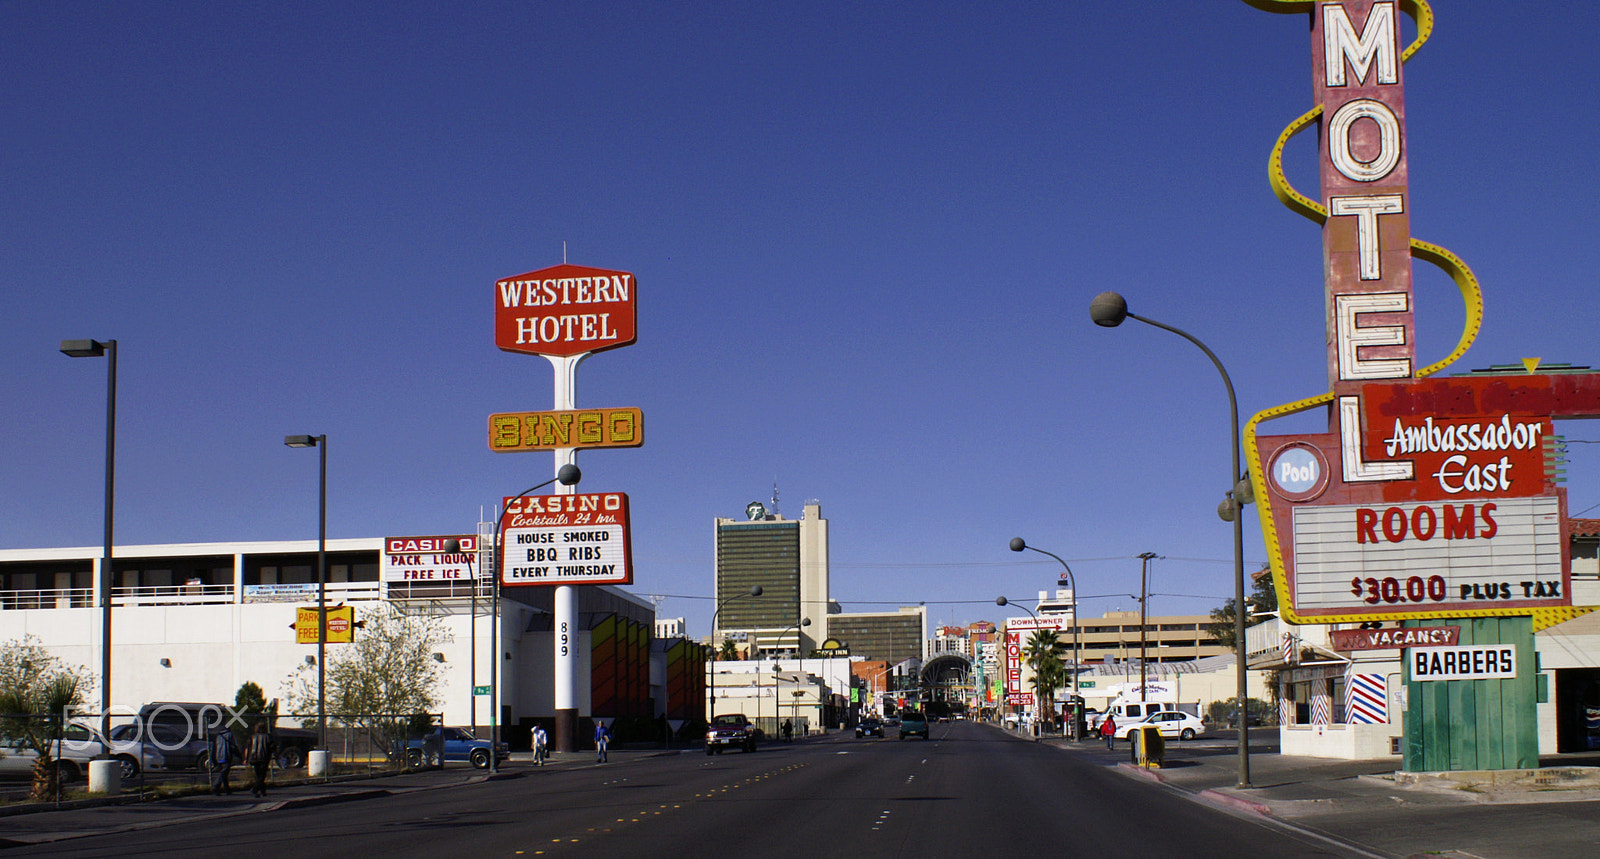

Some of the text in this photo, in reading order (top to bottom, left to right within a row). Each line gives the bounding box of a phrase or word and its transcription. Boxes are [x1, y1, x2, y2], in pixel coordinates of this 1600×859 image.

[1321, 1, 1415, 483] MOTEL
[498, 275, 631, 308] WESTERN
[515, 313, 617, 344] HOTEL
[494, 411, 635, 447] BINGO
[1383, 413, 1543, 457] Ambassador
[1280, 460, 1315, 482] Pool
[1432, 454, 1513, 494] East
[505, 494, 620, 514] CASINO
[511, 513, 617, 527] Cocktails 24 hrs.
[1355, 502, 1498, 544] ROOMS
[390, 538, 473, 552] CASIO
[517, 531, 610, 544] HOUSE SMOKED
[391, 553, 476, 566] PACK. LIQUOR
[527, 546, 602, 562] BBQ RIBS
[404, 568, 461, 580] FREE ICE
[512, 564, 616, 578] EVERY THURSDAY
[1351, 574, 1561, 604] $30.00 PLUS TAX
[1011, 617, 1063, 626] DOWNTOWNER
[298, 627, 319, 639] FREE
[560, 622, 568, 657] 899
[1368, 629, 1454, 646] VACANCY
[1008, 632, 1020, 693] MOTEL
[1415, 649, 1512, 676] BARBERS
